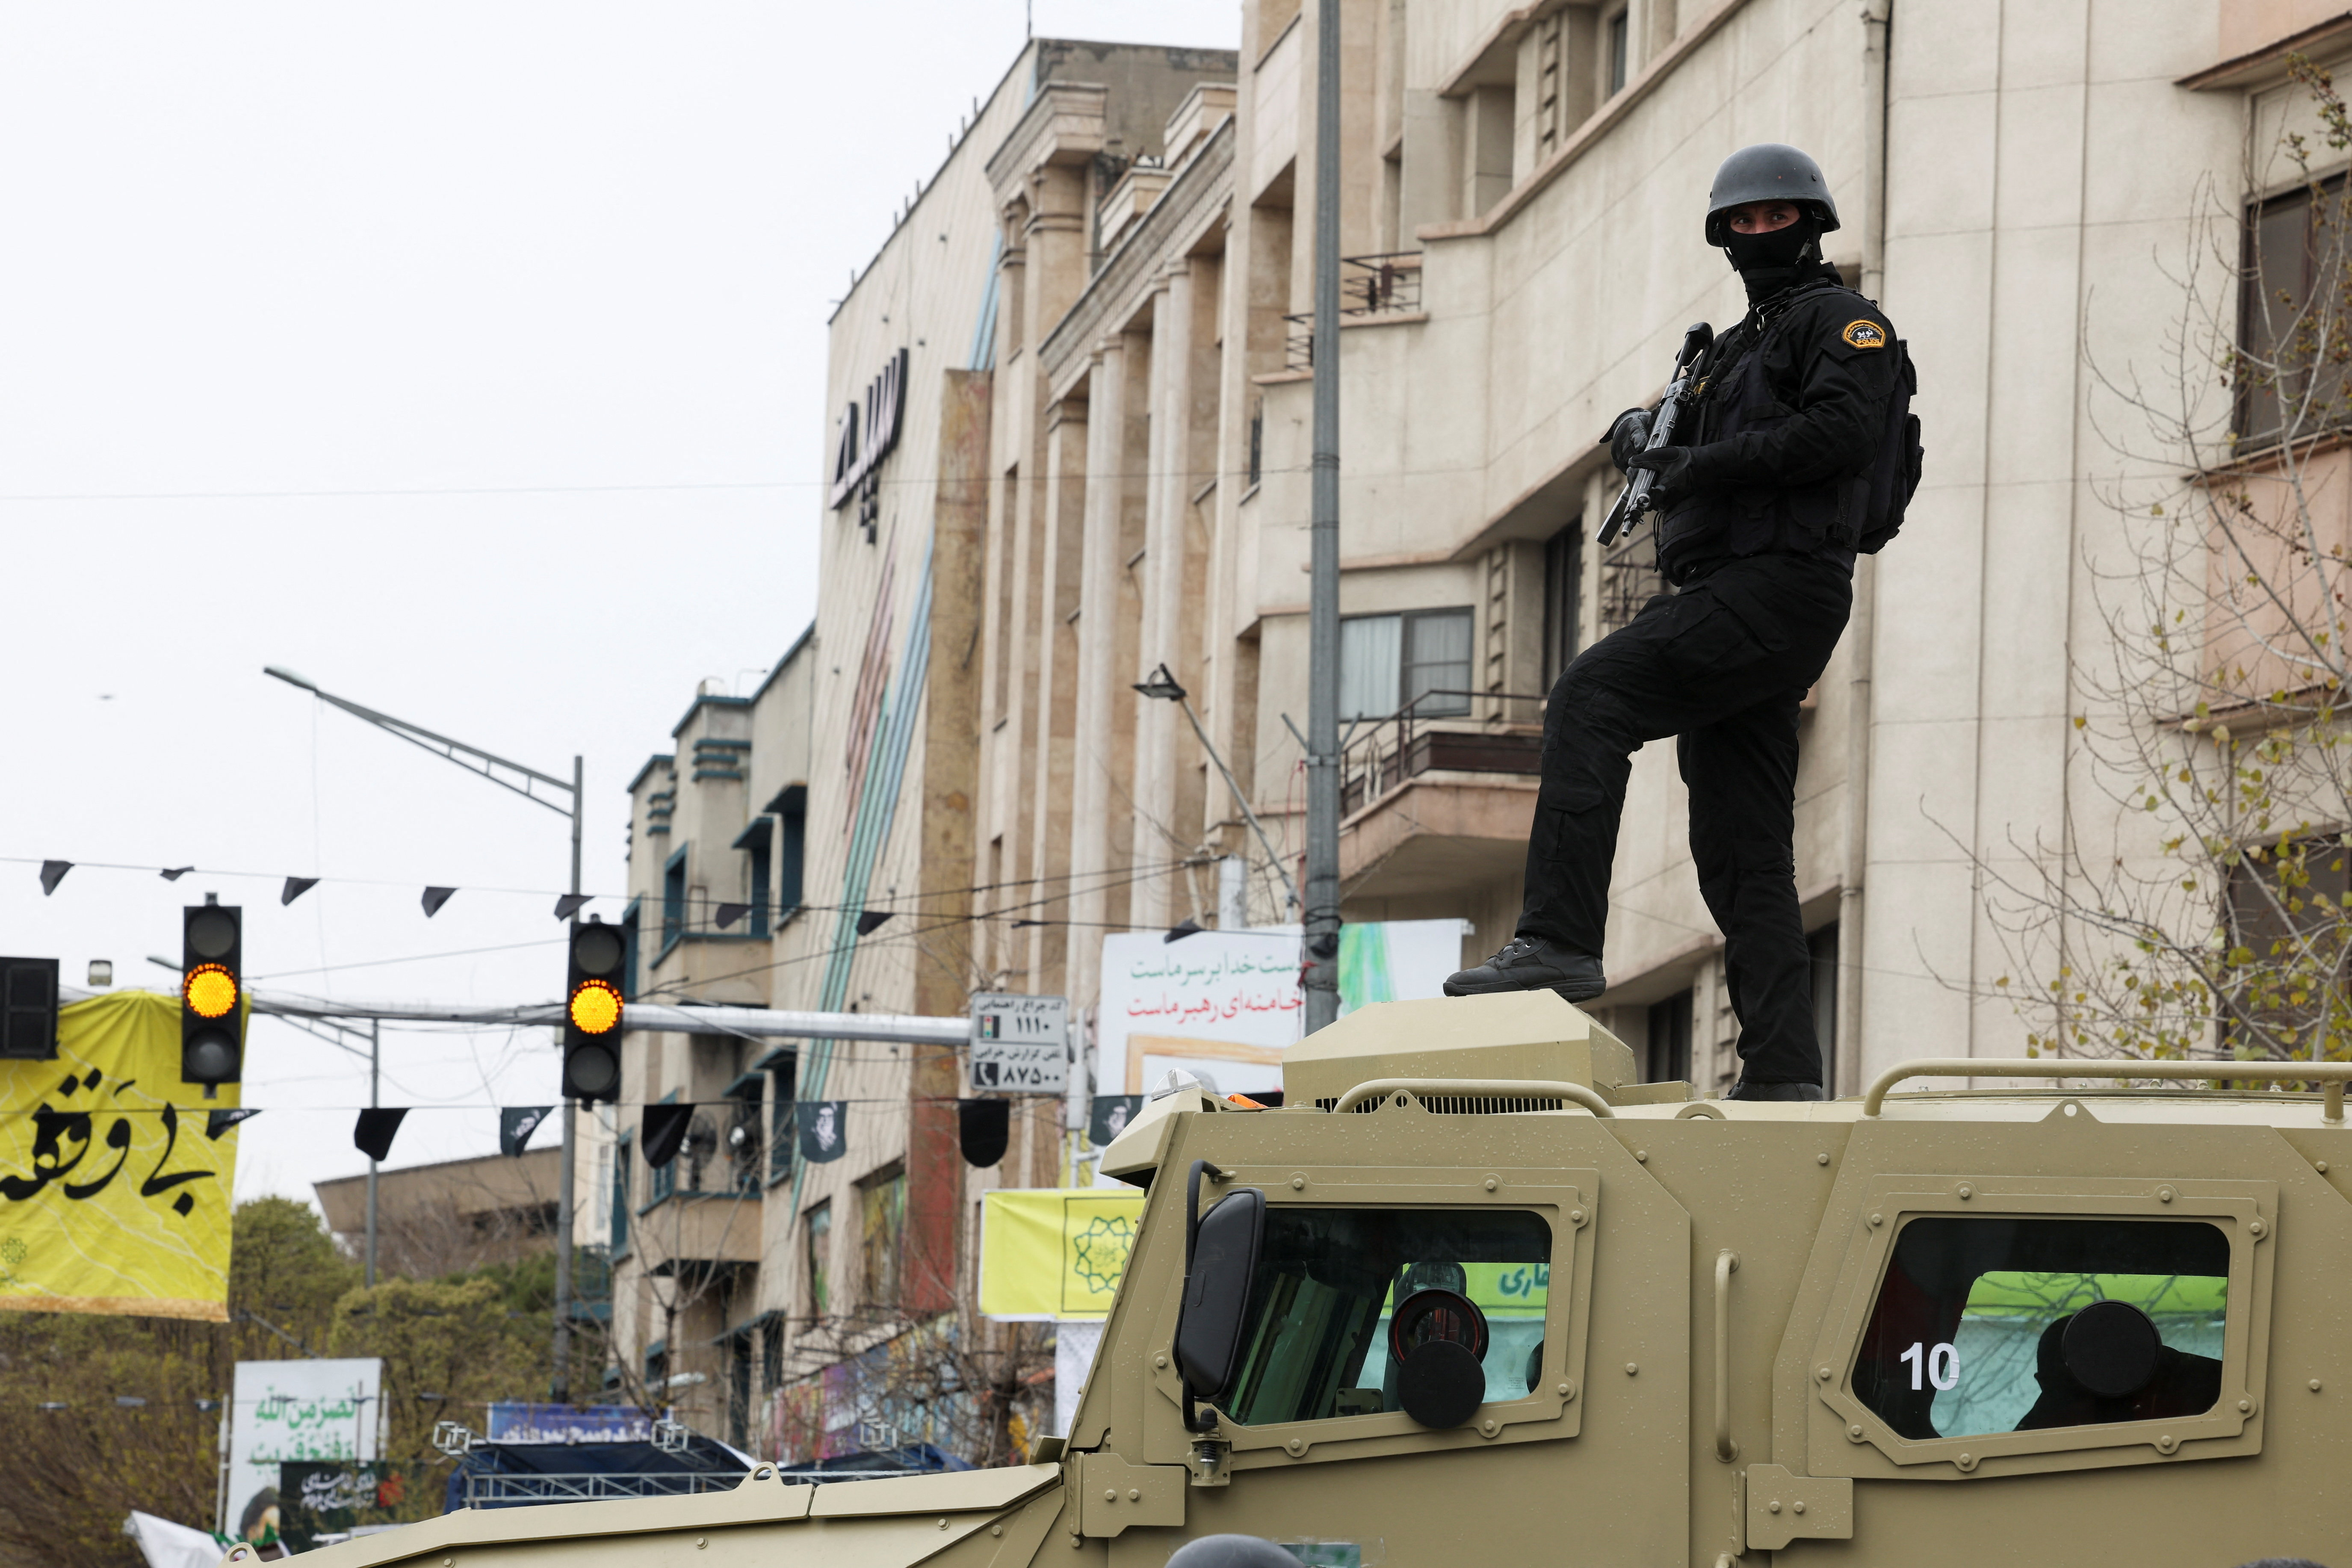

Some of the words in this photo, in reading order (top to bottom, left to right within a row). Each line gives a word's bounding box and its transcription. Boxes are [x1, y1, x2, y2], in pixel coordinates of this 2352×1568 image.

[1223, 951, 1255, 975] خدا
[1004, 1066, 1060, 1084] ۸۷۵۰۰
[1900, 1342, 1960, 1391] 10
